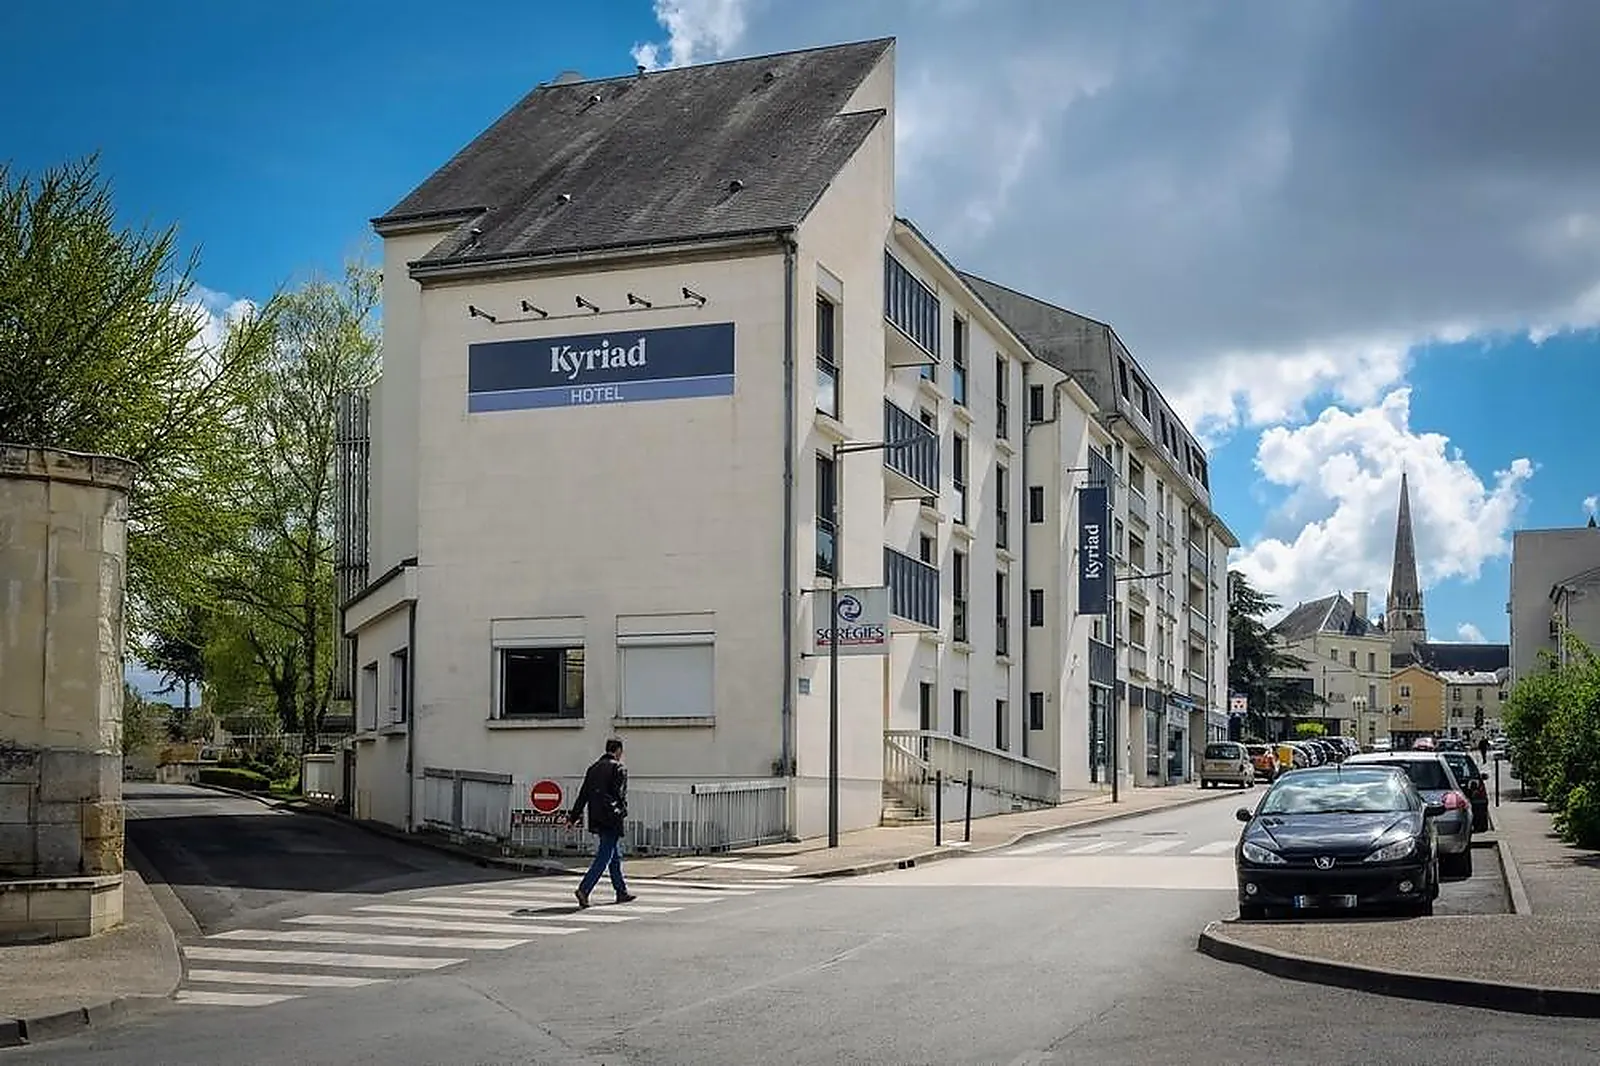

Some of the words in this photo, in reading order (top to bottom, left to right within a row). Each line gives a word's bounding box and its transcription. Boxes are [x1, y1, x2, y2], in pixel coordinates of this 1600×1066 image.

[550, 337, 647, 380] Kyriad
[570, 385, 624, 403] HOTEL
[1084, 524, 1103, 579] Kyriad
